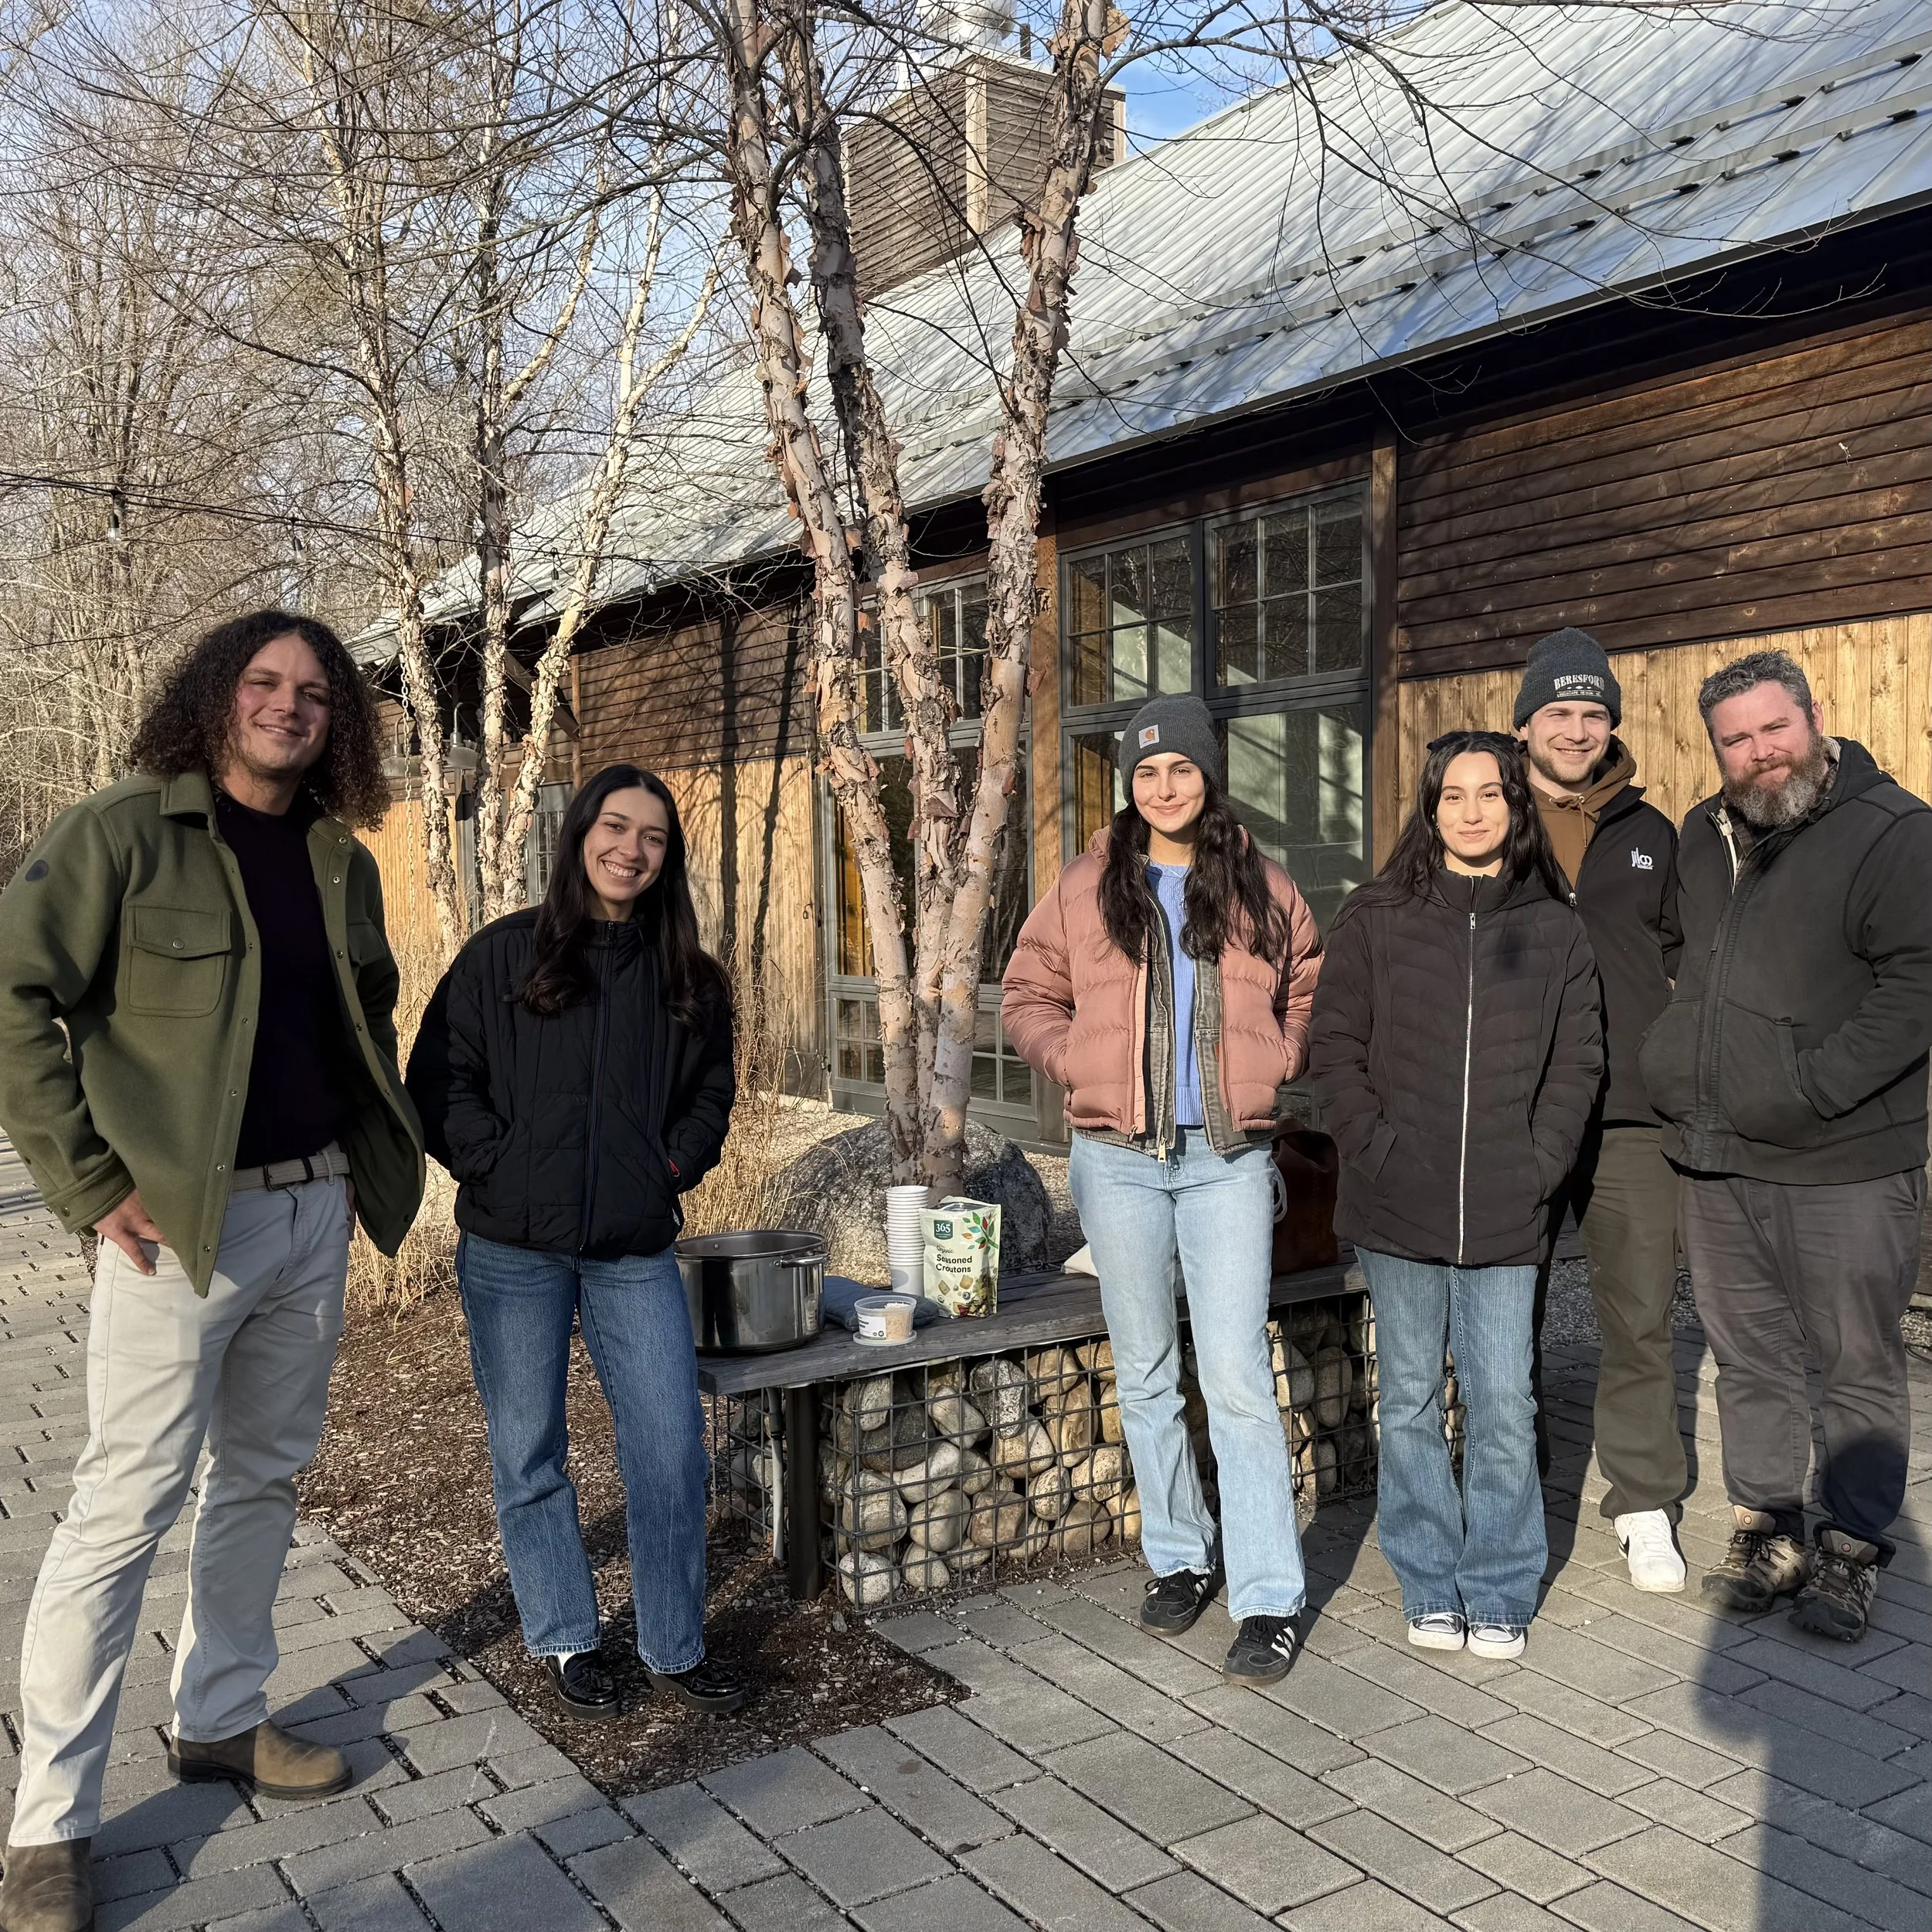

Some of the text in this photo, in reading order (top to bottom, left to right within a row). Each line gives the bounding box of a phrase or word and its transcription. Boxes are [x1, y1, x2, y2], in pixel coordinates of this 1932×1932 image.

[1553, 674, 1605, 691] BERESFORD
[936, 1223, 951, 1233] 365
[937, 1253, 973, 1264] Seasoned
[936, 1263, 971, 1274] Croutons
